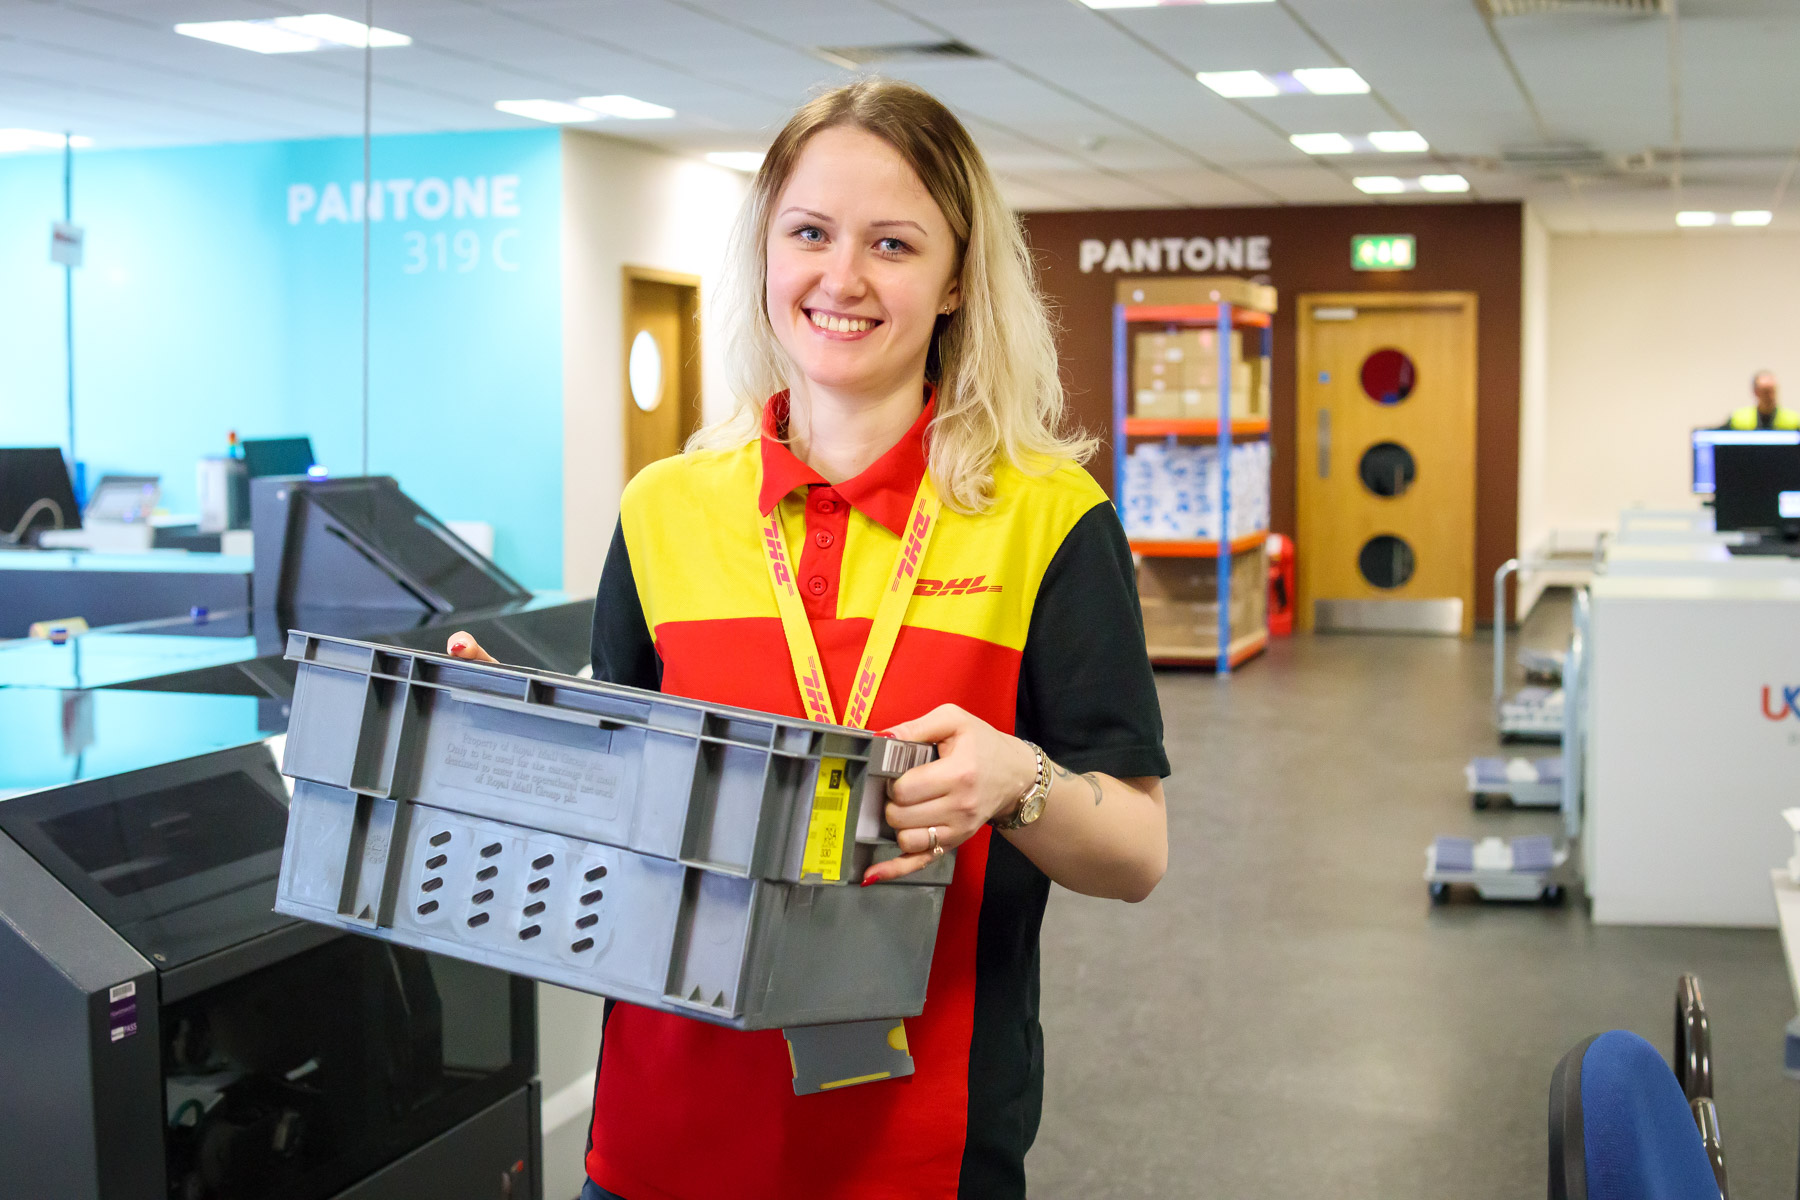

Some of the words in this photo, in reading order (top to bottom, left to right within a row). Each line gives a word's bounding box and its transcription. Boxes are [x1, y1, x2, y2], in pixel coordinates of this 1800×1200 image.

[287, 174, 521, 225] PANTONE
[403, 229, 480, 275] 319
[491, 228, 521, 273] C
[1079, 236, 1273, 273] PANTONE
[764, 516, 793, 592] DHL
[894, 504, 930, 586] DHL
[912, 575, 1002, 596] DHL
[847, 662, 876, 729] DH
[481, 750, 493, 760] be
[496, 753, 514, 766] used
[516, 769, 531, 781] the
[485, 774, 509, 790] Royal
[511, 780, 533, 794] Mail
[535, 784, 562, 802] Group
